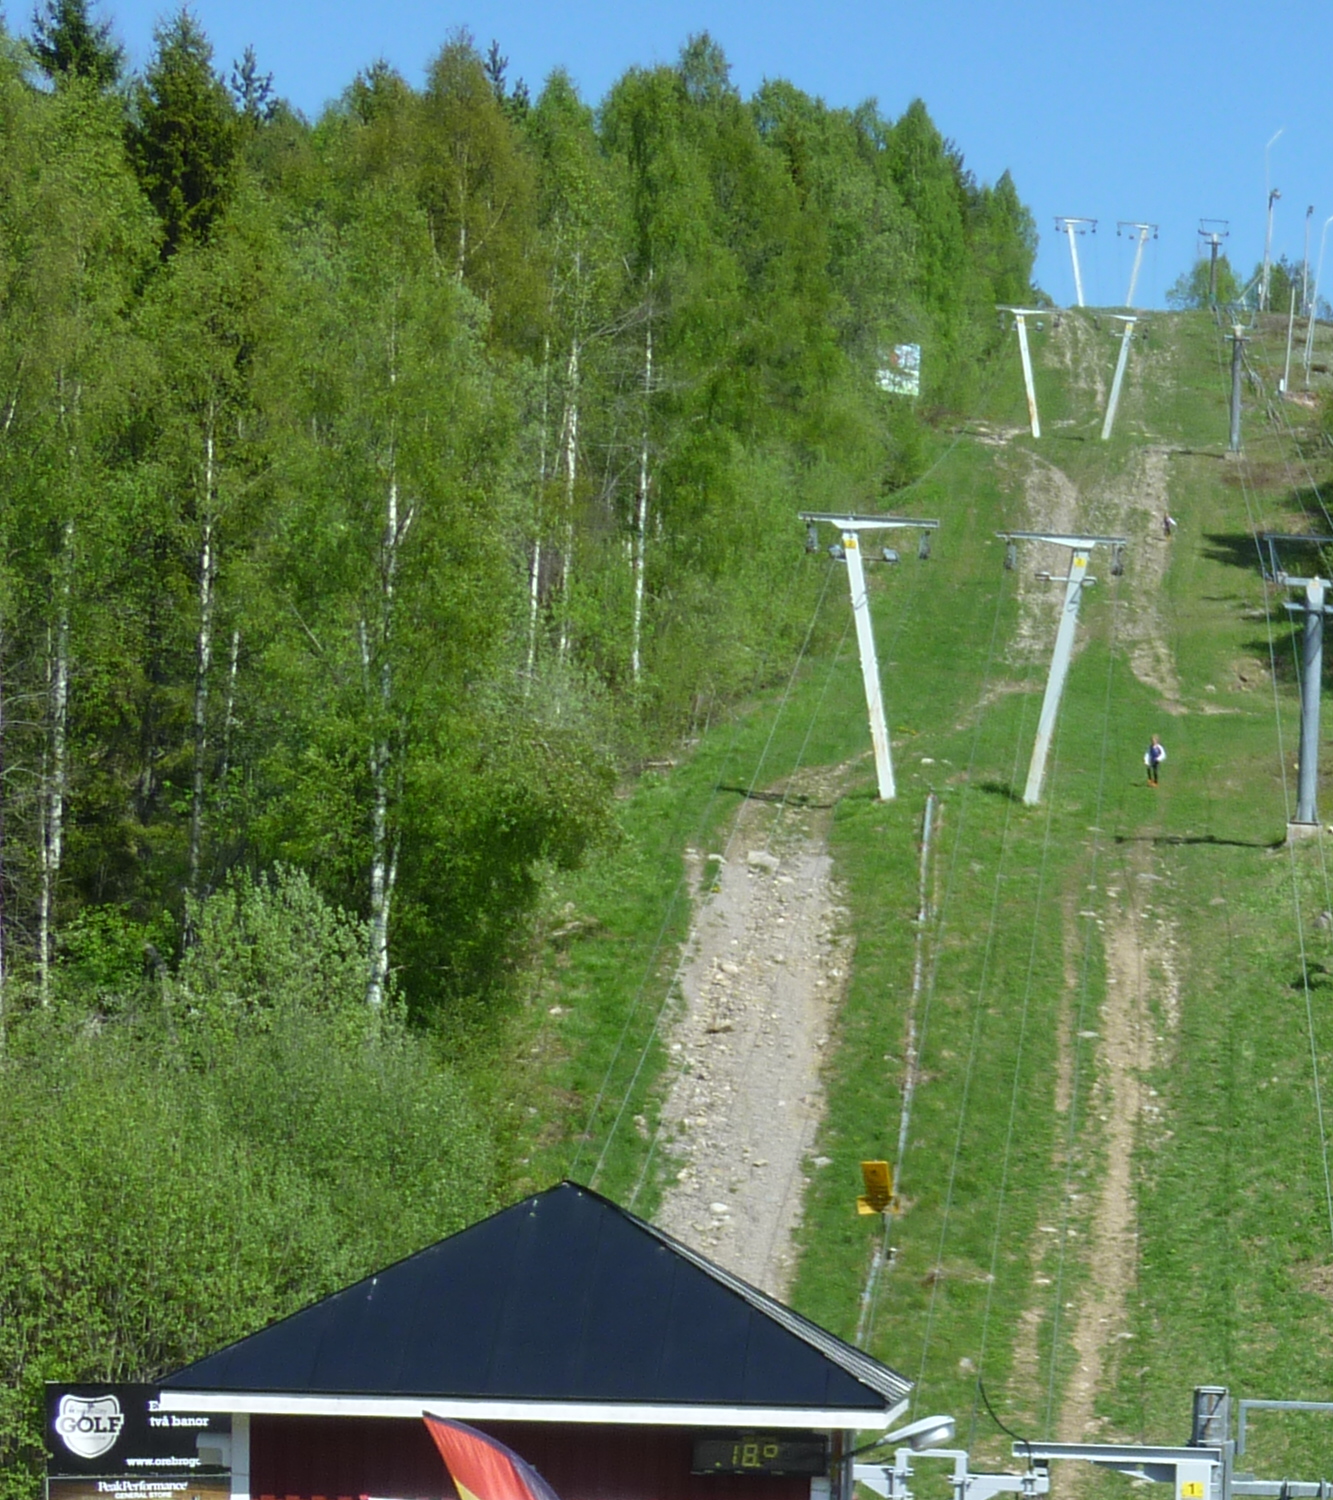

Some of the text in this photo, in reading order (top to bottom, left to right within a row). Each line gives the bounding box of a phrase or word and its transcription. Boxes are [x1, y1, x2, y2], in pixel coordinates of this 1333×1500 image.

[60, 1416, 121, 1433] GOLF
[150, 1415, 209, 1427] två banor
[1187, 1482, 1195, 1495] 1
